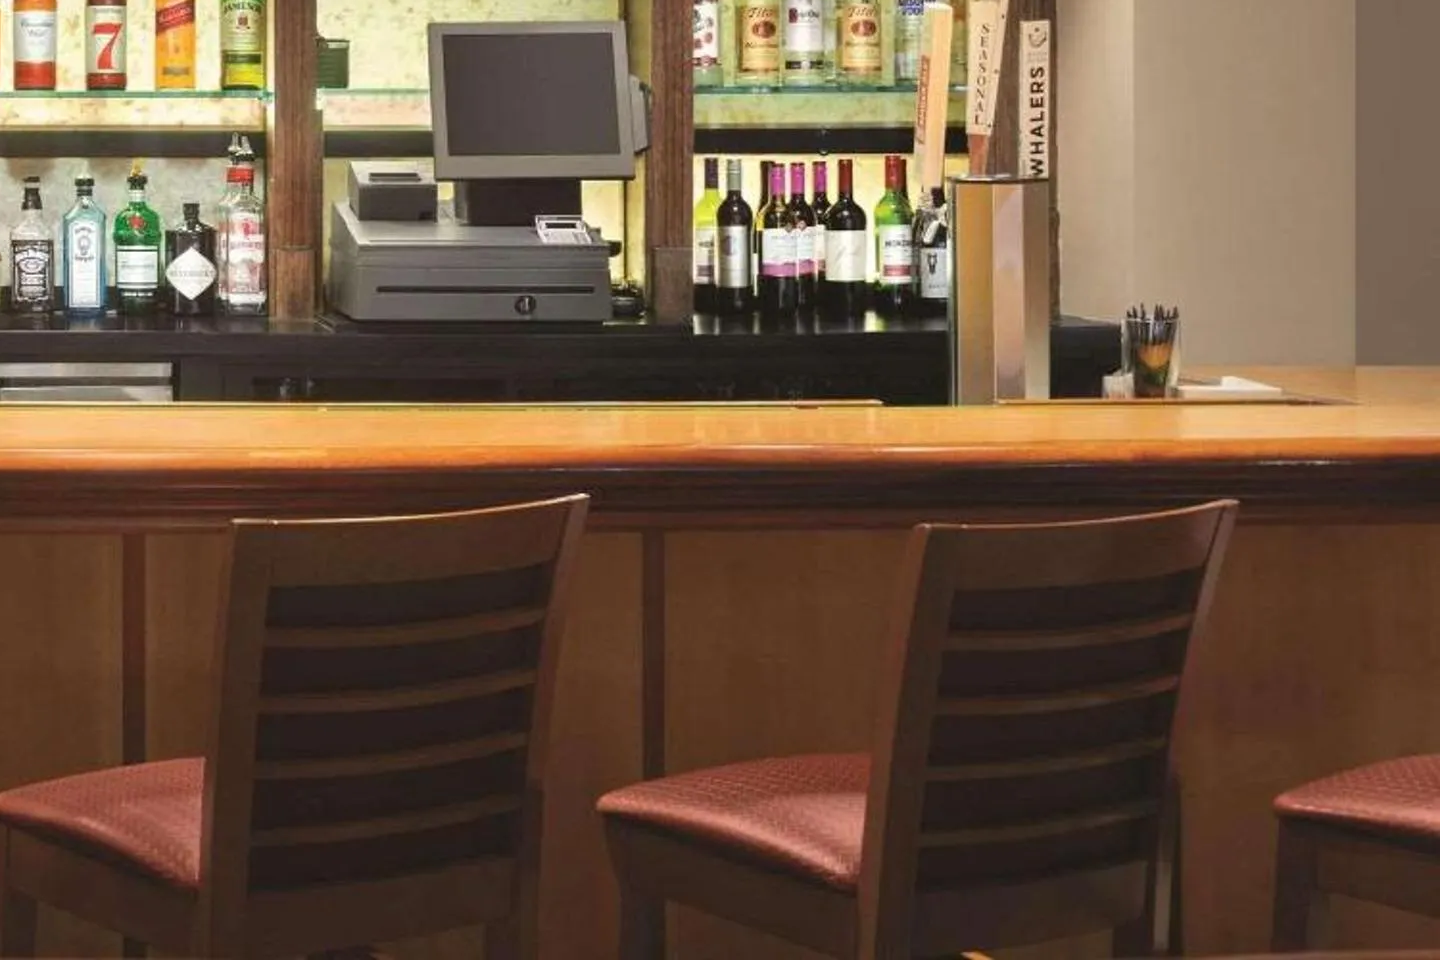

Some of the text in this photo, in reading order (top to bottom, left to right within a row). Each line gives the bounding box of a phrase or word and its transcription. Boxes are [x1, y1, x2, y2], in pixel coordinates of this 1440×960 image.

[91, 21, 123, 70] 7
[973, 23, 991, 126] SEASONAL
[1030, 66, 1045, 176] WHALERS
